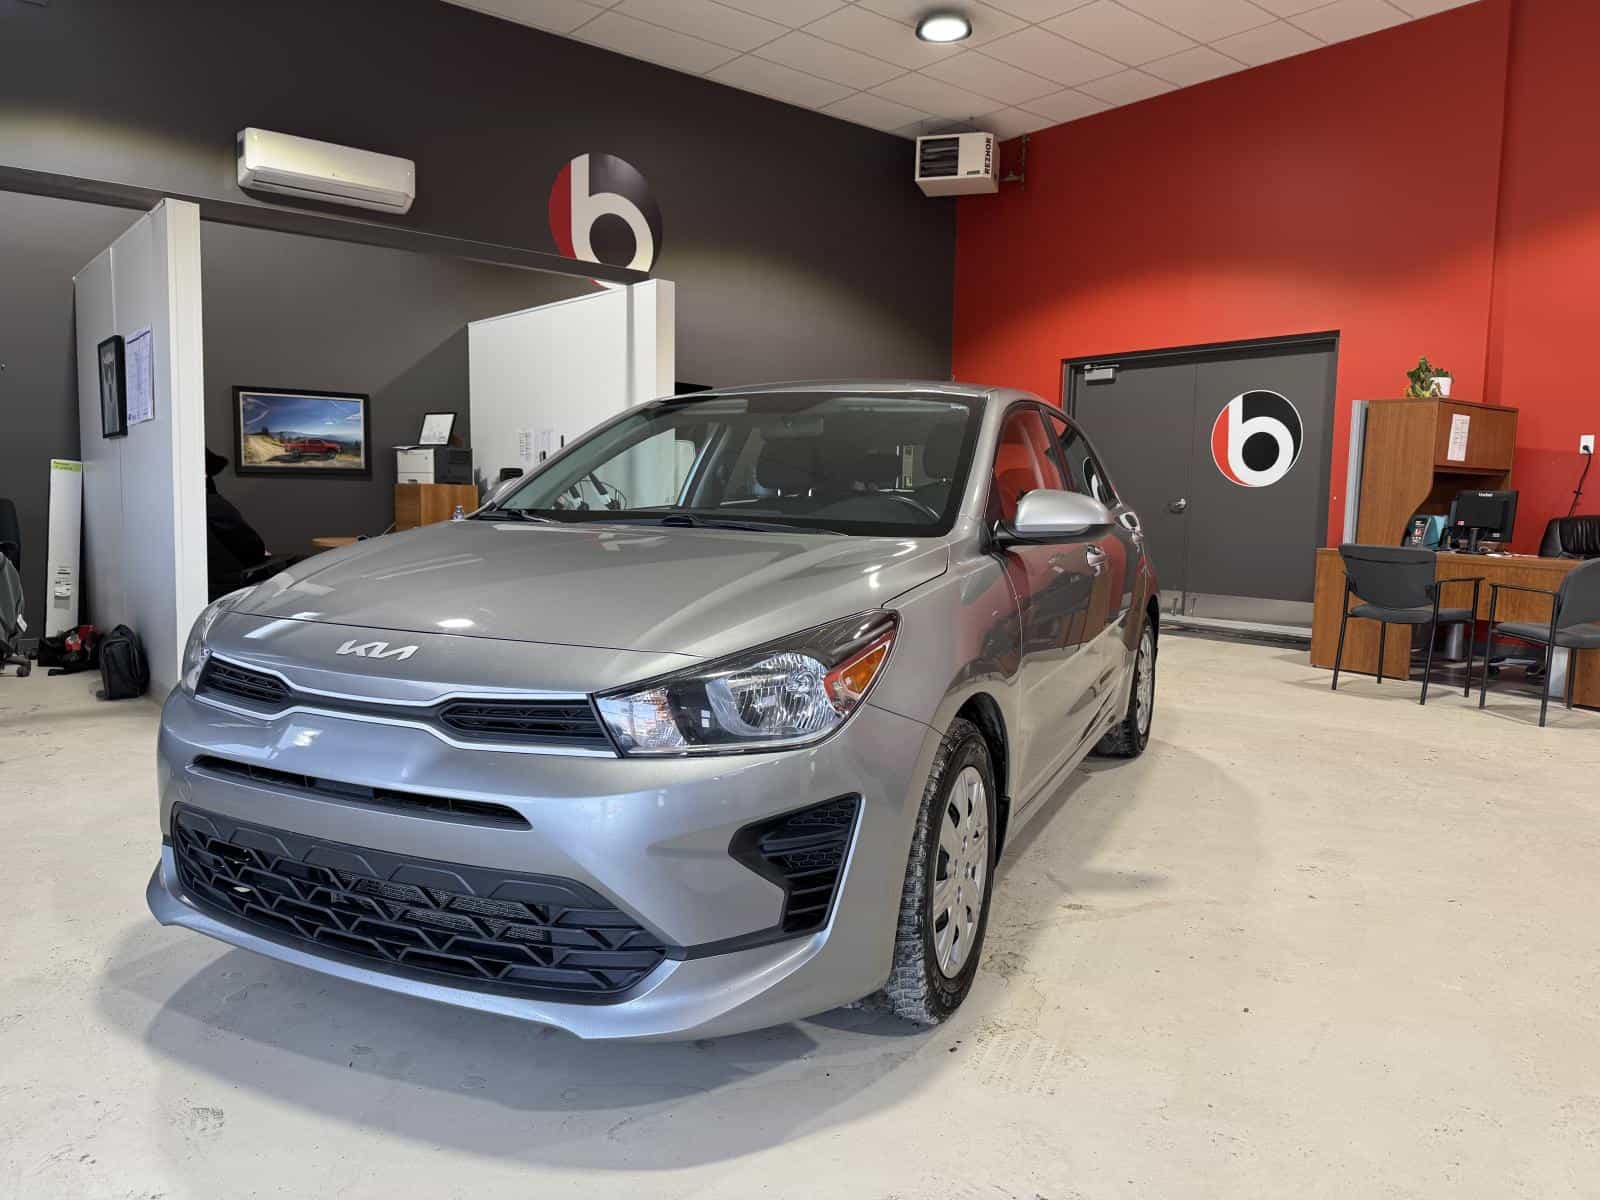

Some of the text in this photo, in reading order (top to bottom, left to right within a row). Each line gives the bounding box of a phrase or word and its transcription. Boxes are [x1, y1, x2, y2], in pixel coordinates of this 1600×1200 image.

[984, 137, 993, 175] REZNOR
[1227, 393, 1295, 487] b
[335, 639, 419, 661] KIA
